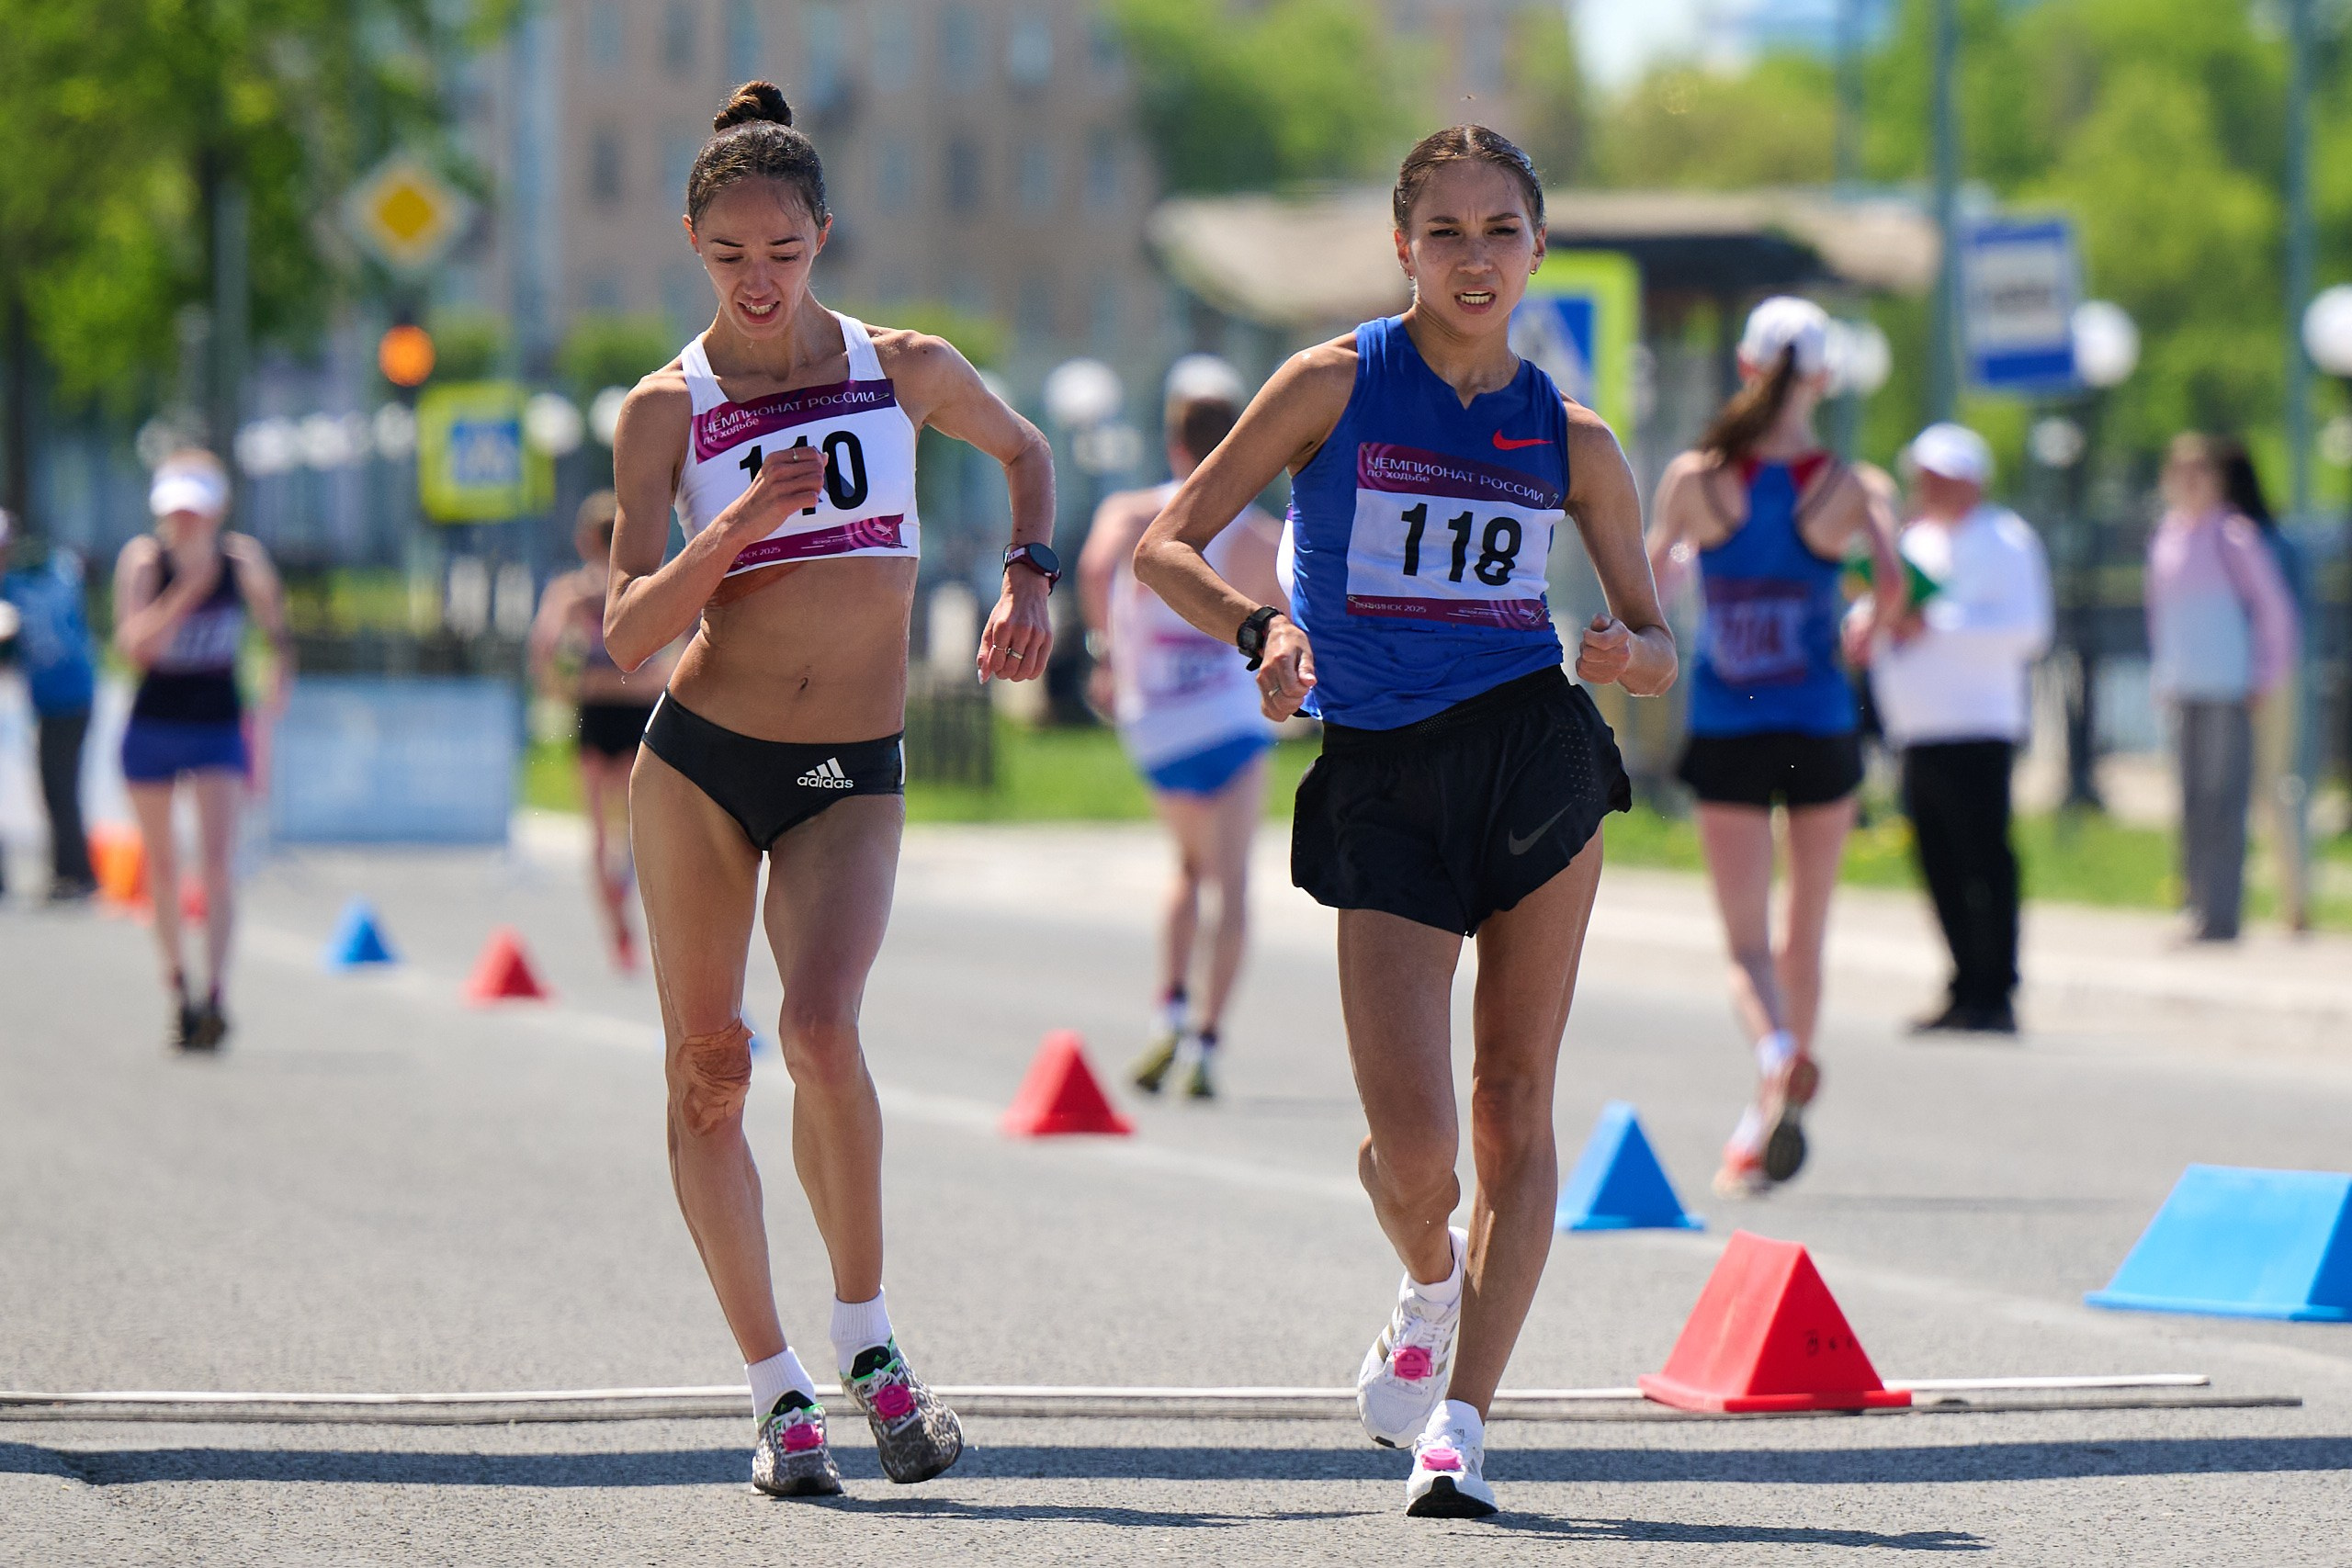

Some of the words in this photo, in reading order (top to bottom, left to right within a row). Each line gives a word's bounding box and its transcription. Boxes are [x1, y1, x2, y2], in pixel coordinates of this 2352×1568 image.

[702, 400, 803, 434] ЧЕМПИОНАТ
[808, 391, 876, 408] РОССИИ
[703, 434, 718, 446] по
[719, 417, 760, 439] ходьбе
[1367, 468, 1382, 478] по
[1385, 471, 1430, 483] ходьбе
[1367, 457, 1473, 483] ЧЕМПИОНАТ
[1480, 475, 1544, 504] РОССИИ
[1401, 502, 1521, 586] 118
[1403, 604, 1427, 613] 2025
[797, 775, 854, 788] adidas
